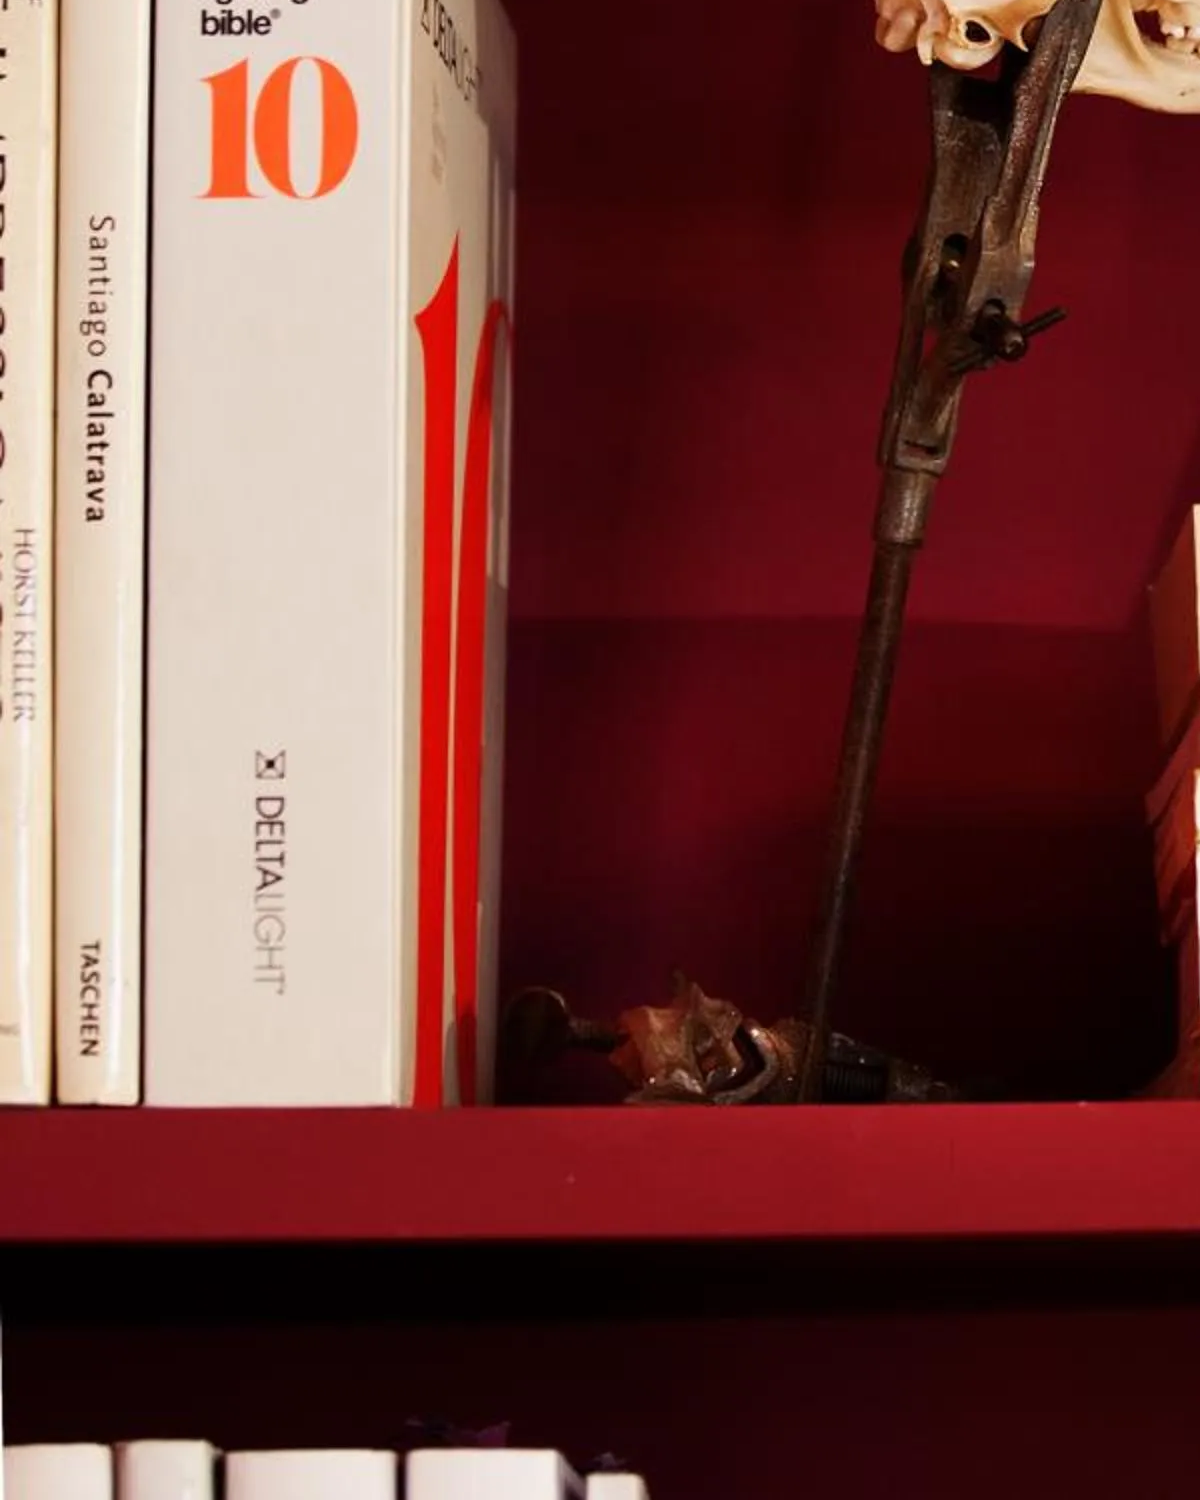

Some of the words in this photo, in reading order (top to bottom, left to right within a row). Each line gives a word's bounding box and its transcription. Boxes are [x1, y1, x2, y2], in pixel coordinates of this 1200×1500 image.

[194, 55, 359, 201] 10
[79, 215, 116, 358] Santiago
[84, 370, 114, 524] Calatrava
[12, 529, 36, 621] HORST
[12, 630, 36, 722] KELLER
[253, 796, 287, 996] DELTALIGHT
[79, 940, 101, 1057] TASCHEN
